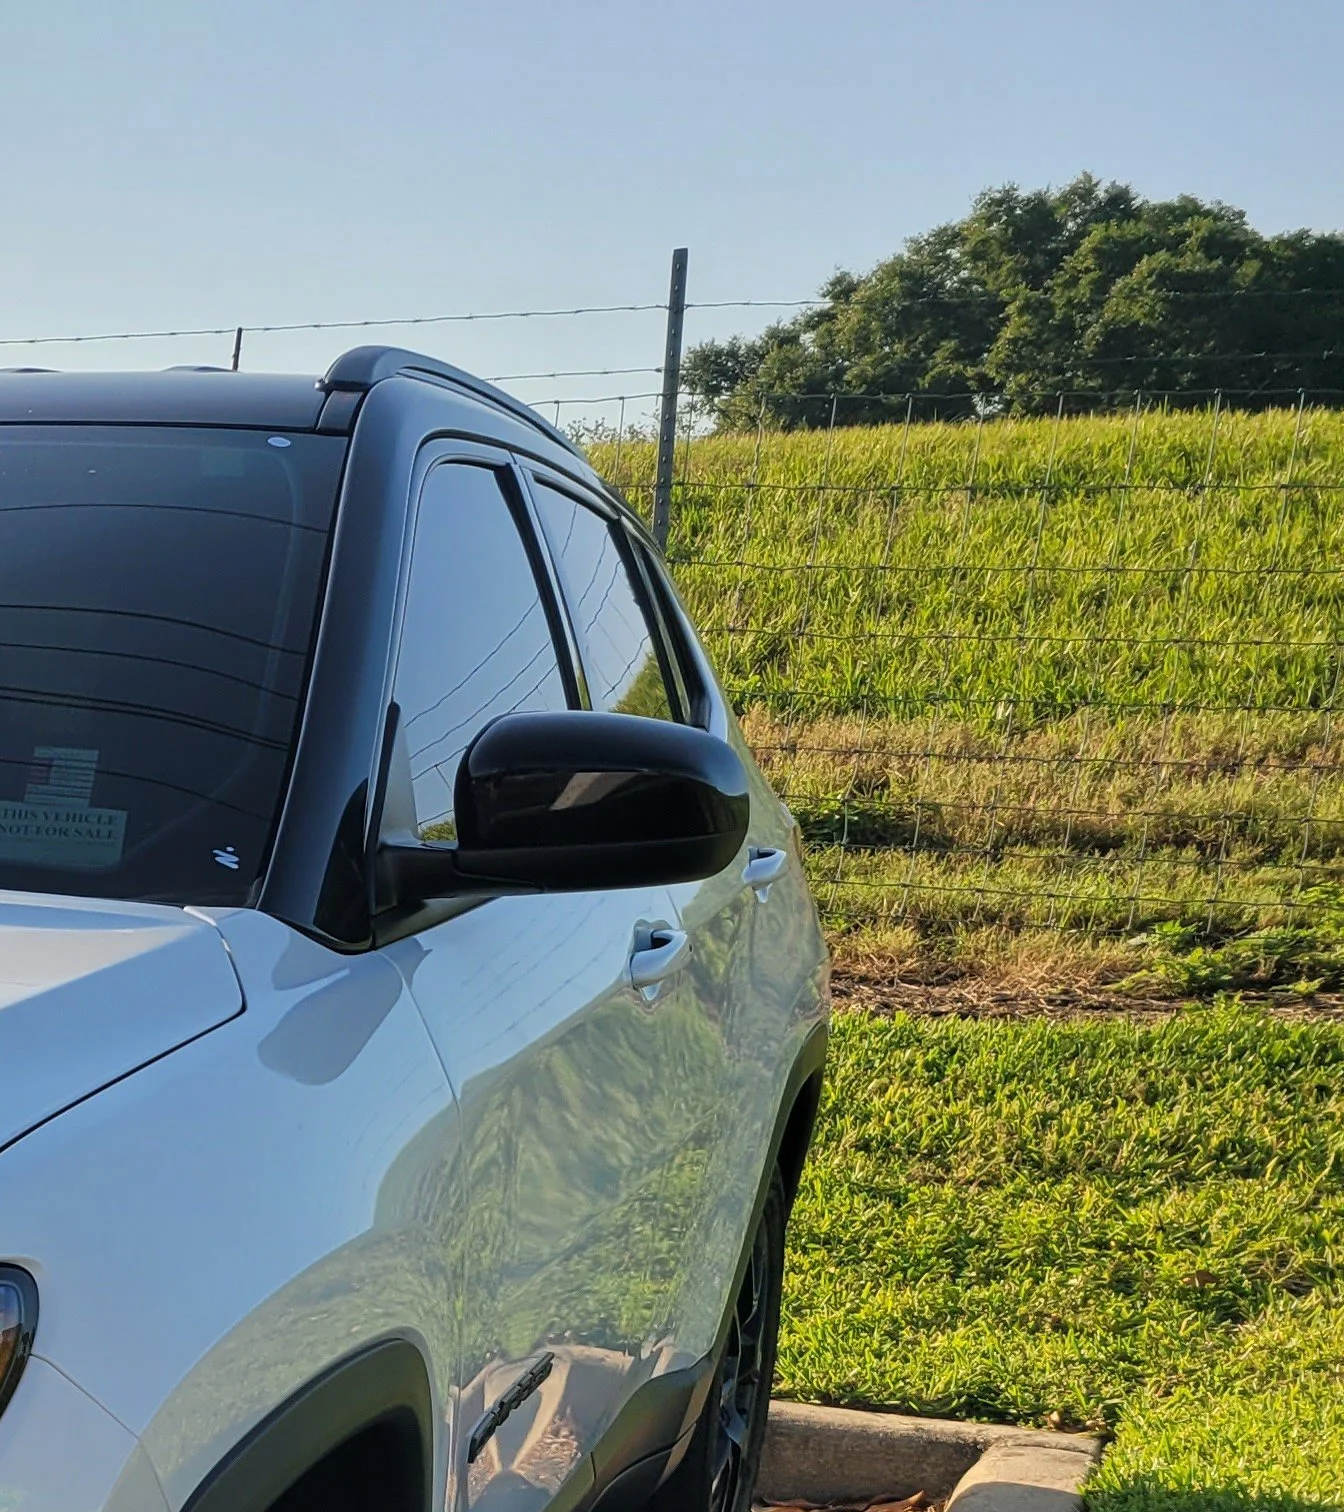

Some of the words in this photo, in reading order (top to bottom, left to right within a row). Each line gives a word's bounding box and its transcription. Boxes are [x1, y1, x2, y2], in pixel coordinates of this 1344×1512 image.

[2, 808, 38, 820] THIS
[42, 811, 117, 826] VEHICLE
[33, 825, 70, 838] FOR
[72, 827, 115, 840] SALE
